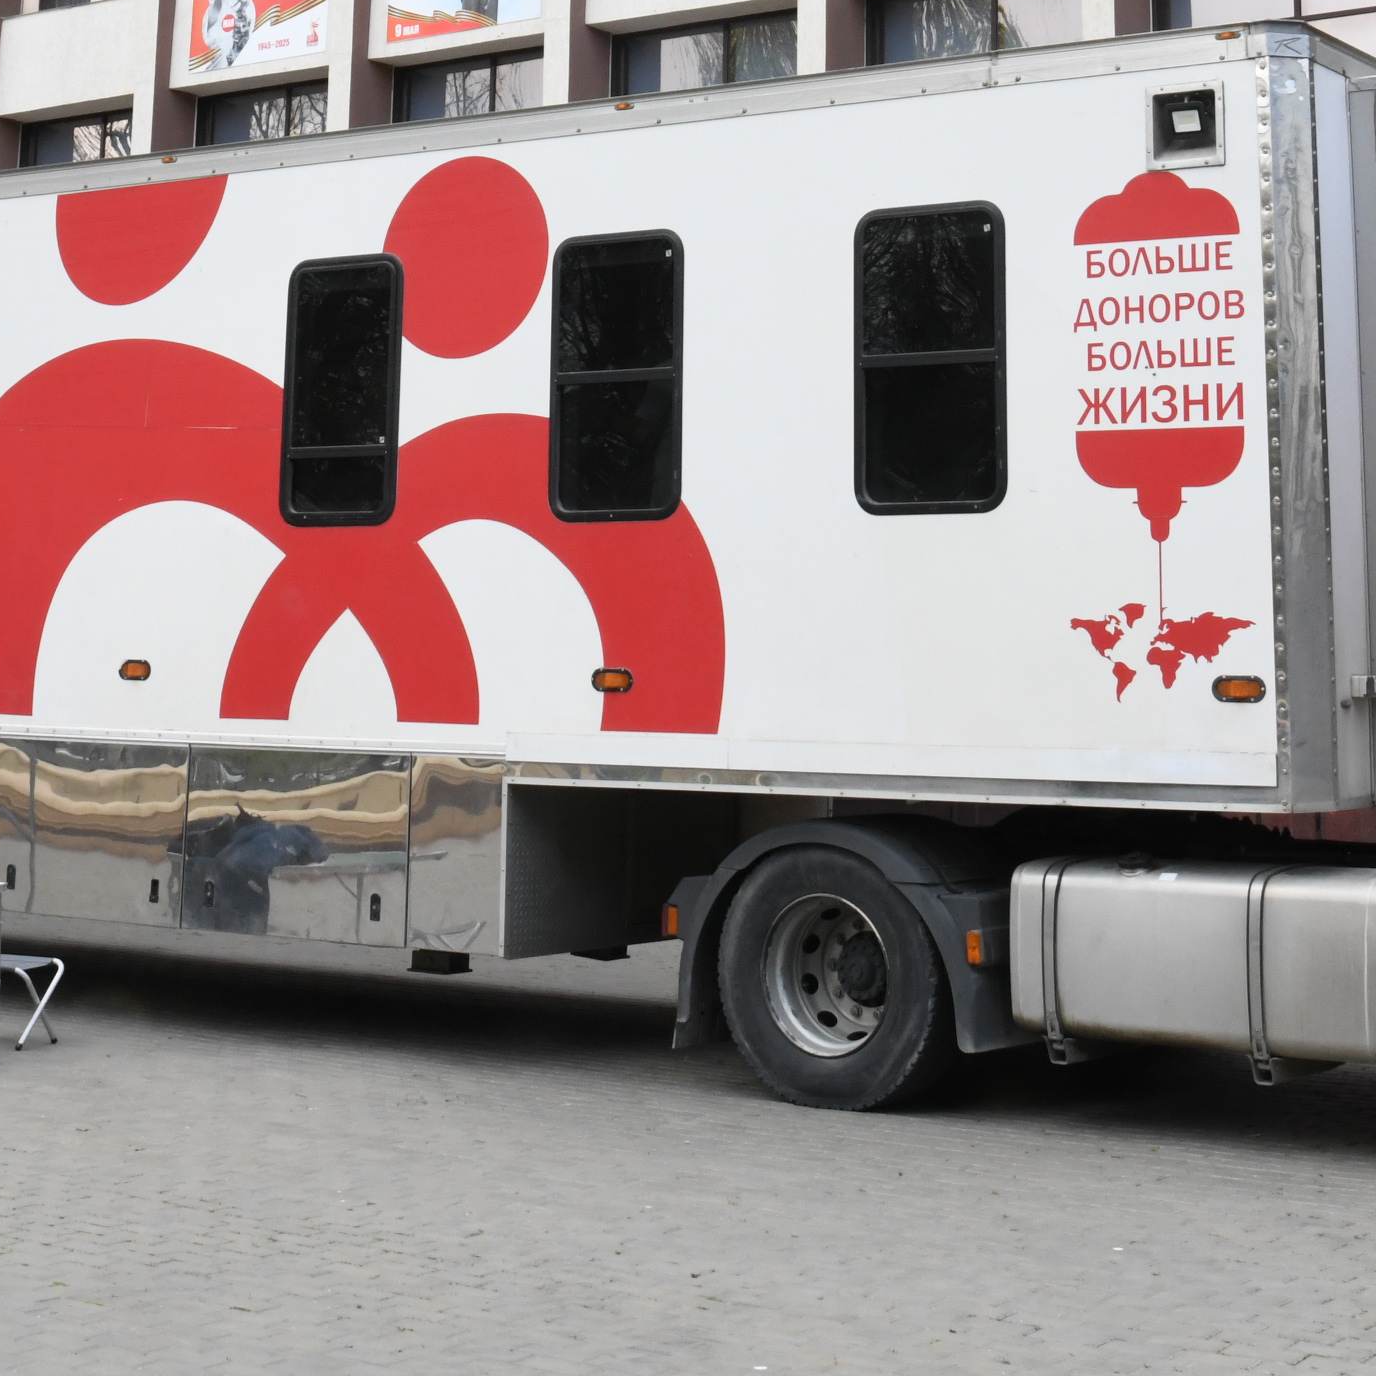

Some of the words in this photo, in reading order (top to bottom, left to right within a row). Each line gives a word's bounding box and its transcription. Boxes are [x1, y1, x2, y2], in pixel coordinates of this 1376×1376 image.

[395, 23, 402, 38] 9
[403, 24, 420, 36] МАЯ
[1085, 240, 1233, 279] БОЛЬШЕ
[1074, 289, 1245, 333] ДОНОРОВ
[1087, 336, 1236, 372] БОЛЬШЕ
[1077, 382, 1244, 425] ЖИЗНИ
